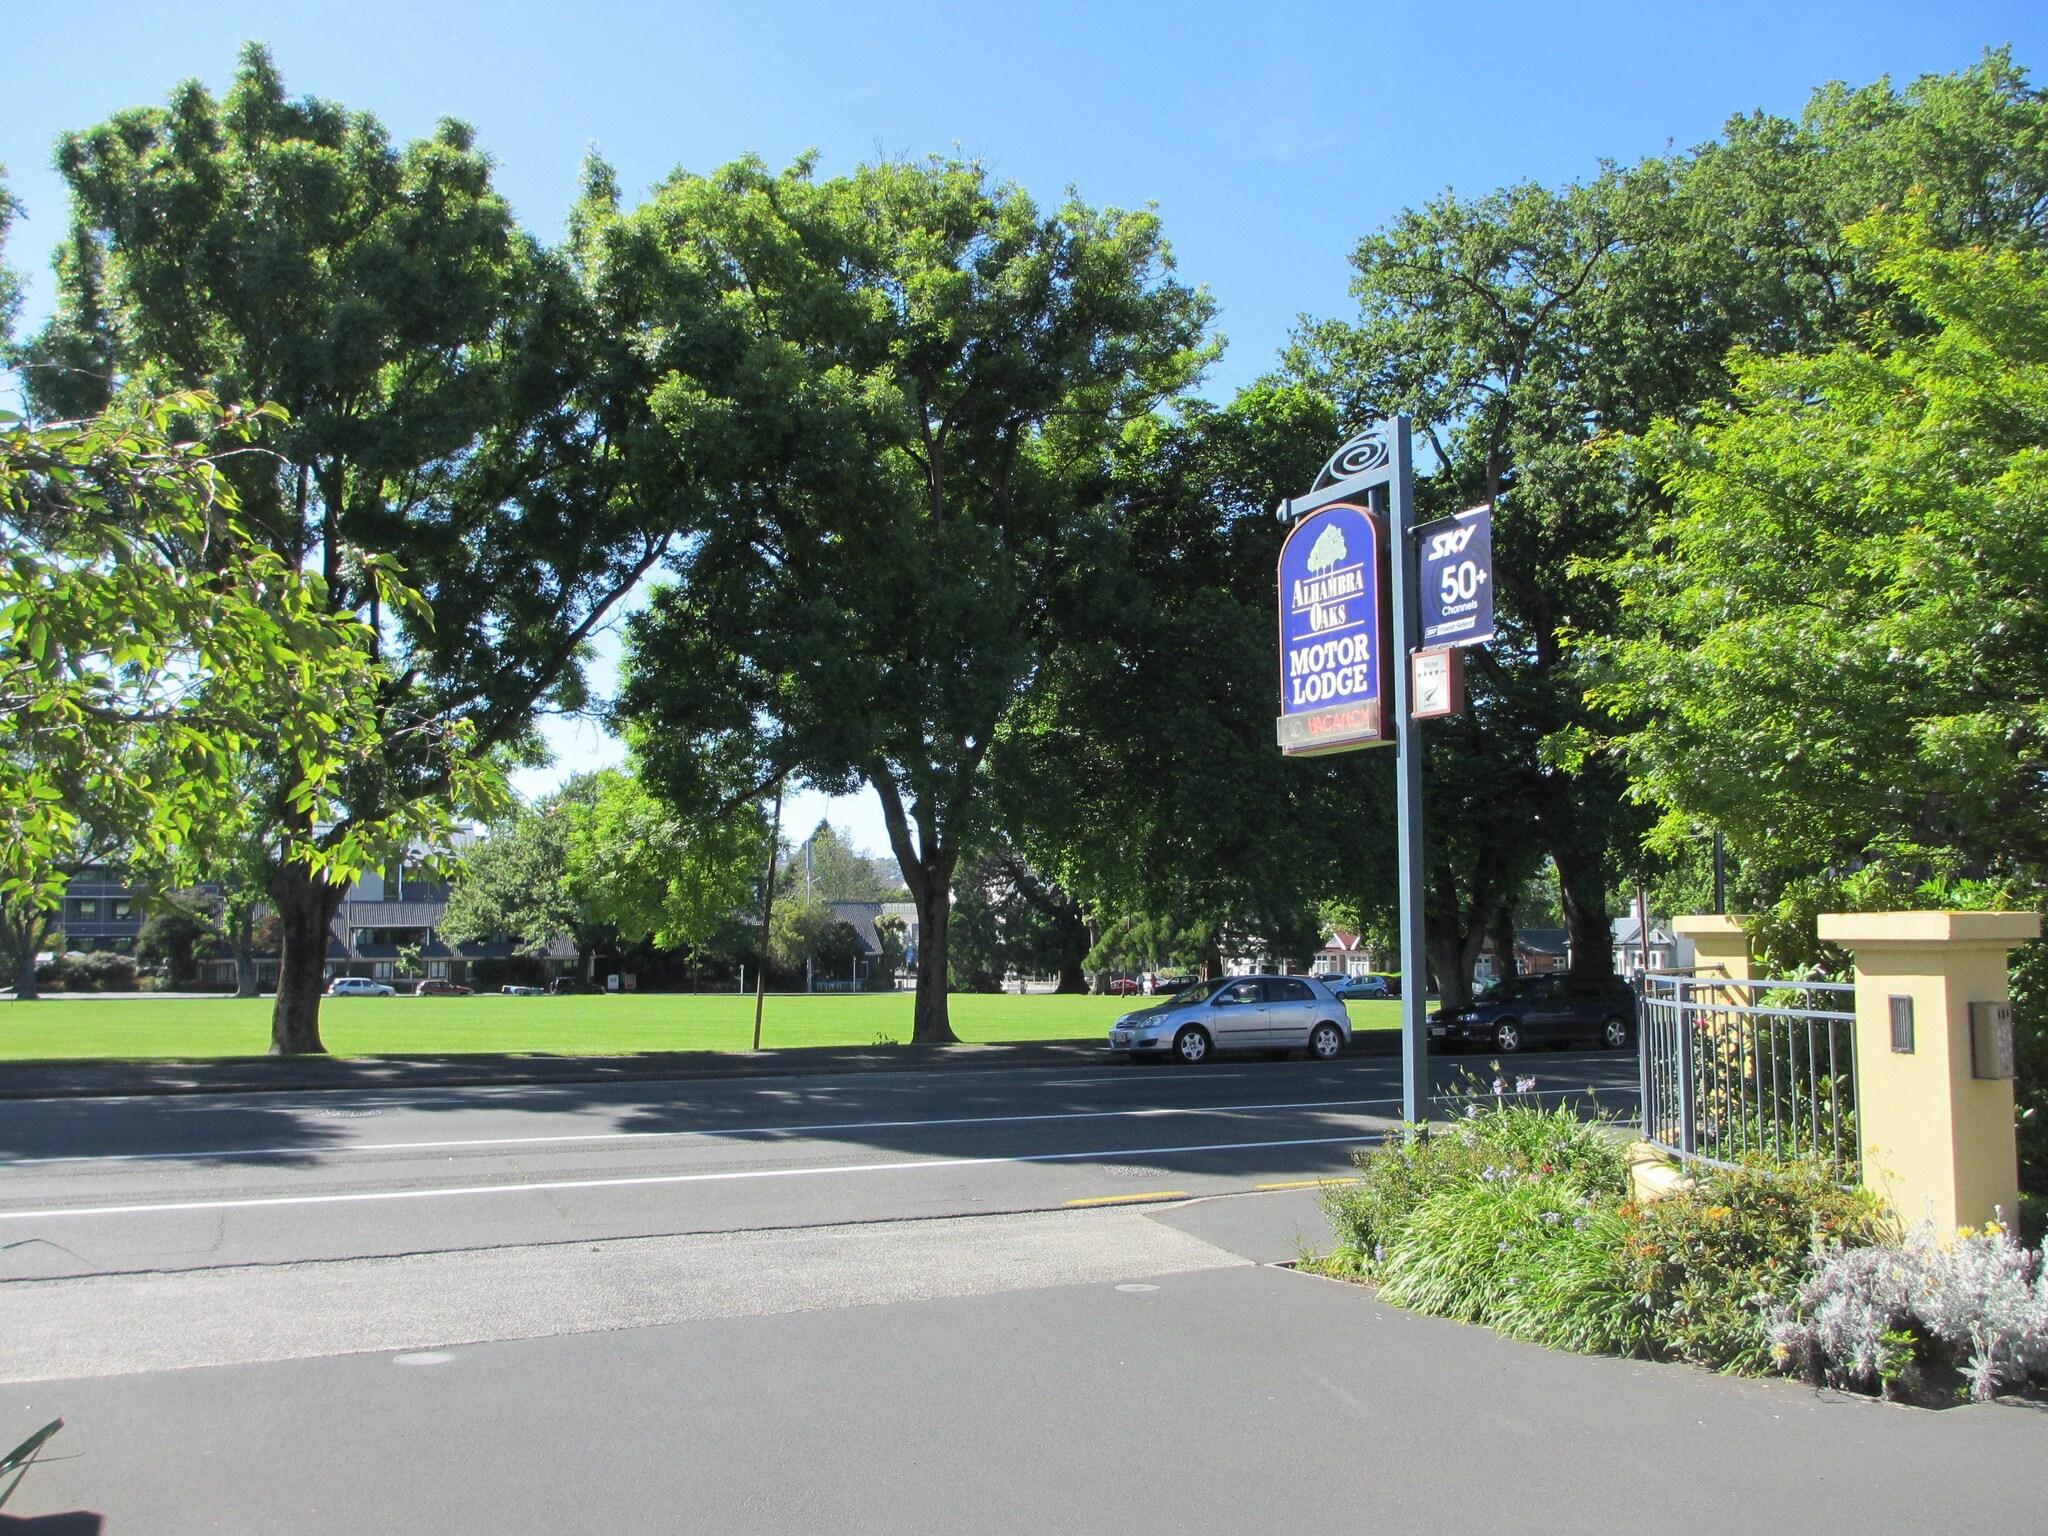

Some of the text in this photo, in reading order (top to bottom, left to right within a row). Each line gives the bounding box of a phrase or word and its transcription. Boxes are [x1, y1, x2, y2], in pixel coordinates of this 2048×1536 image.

[1428, 524, 1477, 561] SKY
[1442, 600, 1478, 616] Channels
[1290, 634, 1370, 677] MOTOR
[1293, 664, 1367, 705] LODGE
